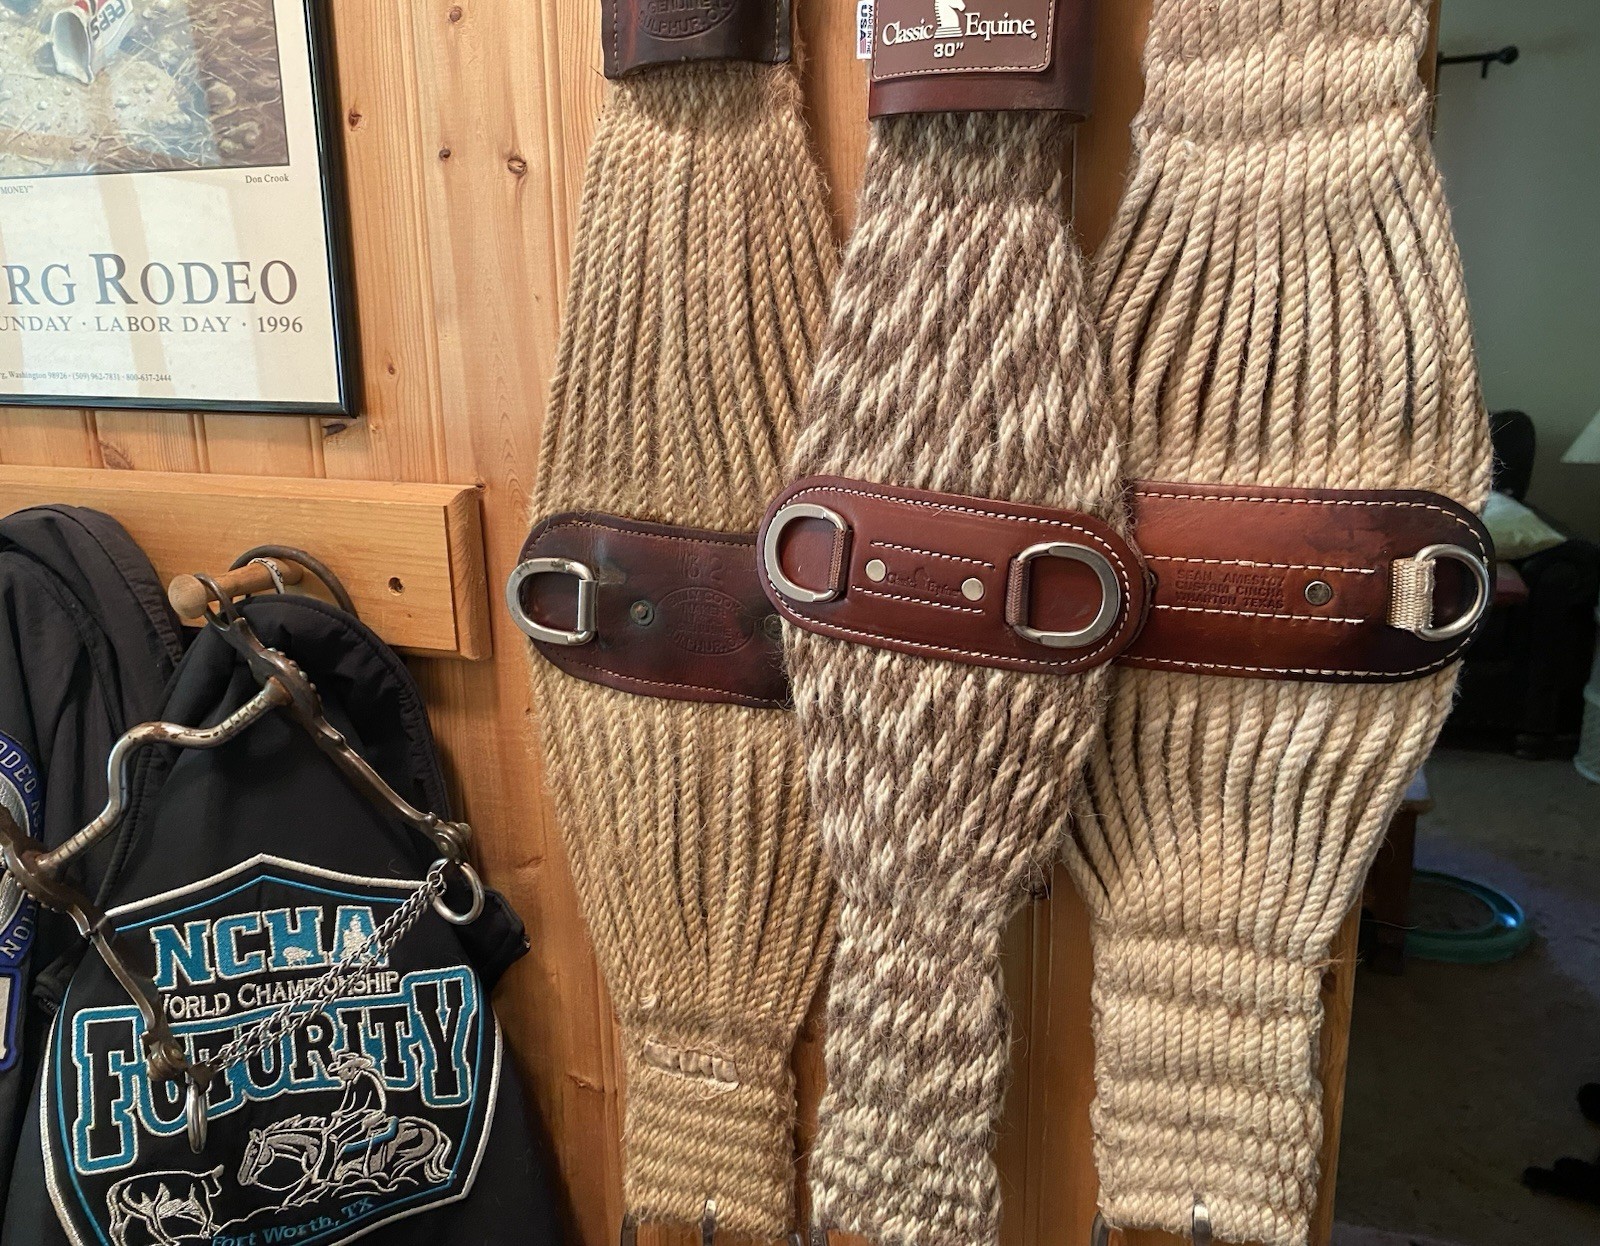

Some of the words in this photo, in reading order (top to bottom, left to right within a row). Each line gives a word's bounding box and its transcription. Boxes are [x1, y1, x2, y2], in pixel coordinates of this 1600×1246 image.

[867, 31, 873, 39] IN
[882, 18, 934, 46] Classic
[245, 175, 263, 184] Don
[264, 173, 290, 184] Crook
[89, 253, 298, 306] RODEO
[95, 316, 174, 333] LABOR
[182, 316, 232, 333] DAY
[257, 315, 304, 334] 1996
[9, 371, 47, 381] Washington
[48, 372, 68, 380] 98926
[1177, 569, 1212, 582] SEAN
[1175, 580, 1230, 595] CUSTOM
[1242, 597, 1285, 610] TEXAS
[149, 904, 391, 992] NCHA
[212, 1231, 257, 1246] Fort
[262, 1215, 341, 1245] Worth,
[341, 1196, 375, 1219] TX
